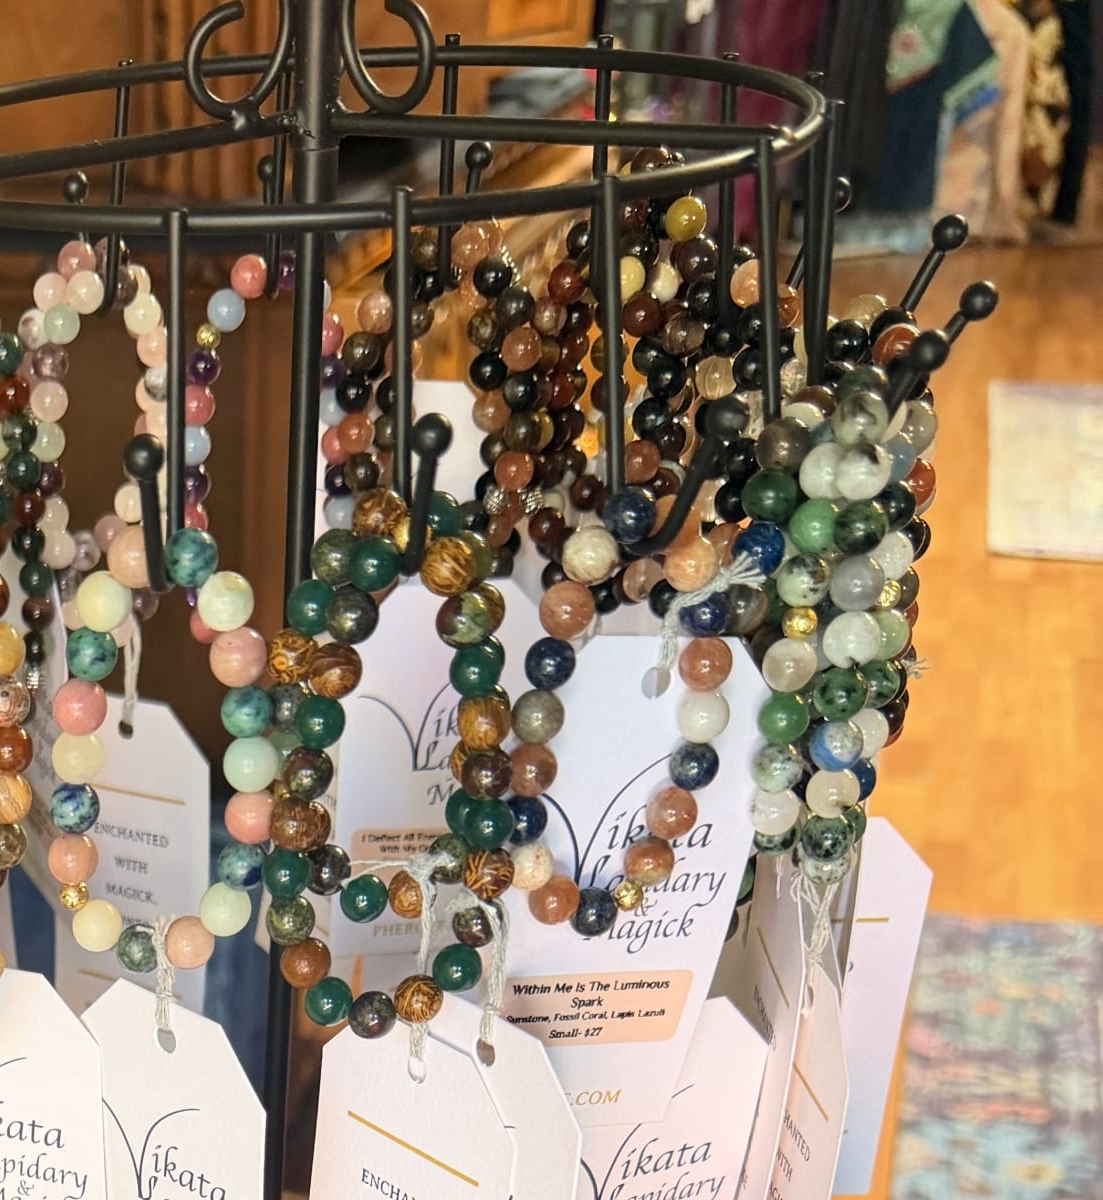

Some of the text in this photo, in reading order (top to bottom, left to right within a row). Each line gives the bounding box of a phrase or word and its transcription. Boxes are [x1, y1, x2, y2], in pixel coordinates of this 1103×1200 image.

[94, 822, 170, 849] ENCHANTED
[114, 856, 149, 874] WITH
[633, 897, 658, 917] &
[513, 979, 670, 996] Within Me Is The Luminous
[571, 996, 603, 1009] Spark
[554, 1012, 579, 1022] Fossil
[582, 1010, 608, 1021] Coral,
[611, 1009, 635, 1020] Lapis
[638, 1008, 665, 1018] Lazuli
[584, 1026, 603, 1038] $27
[783, 1109, 810, 1162] HANTED
[17, 1180, 34, 1196] &
